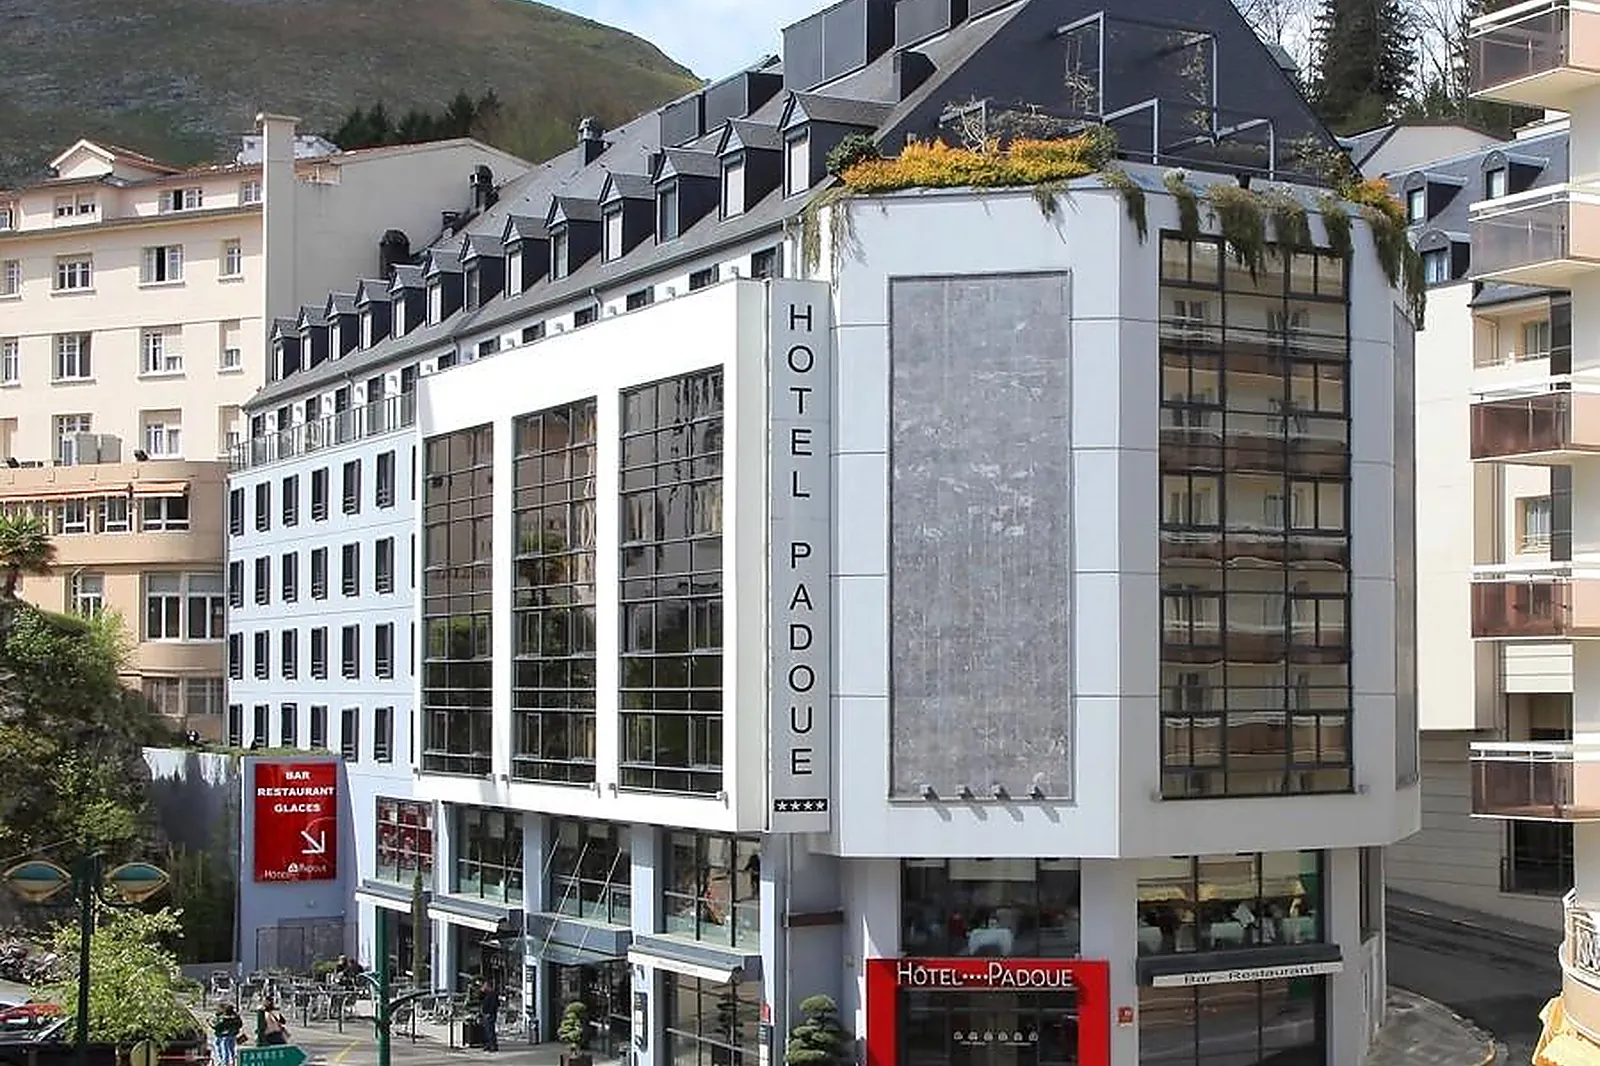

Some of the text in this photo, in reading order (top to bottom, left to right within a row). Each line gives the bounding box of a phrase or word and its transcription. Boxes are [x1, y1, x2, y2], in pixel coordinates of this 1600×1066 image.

[787, 304, 815, 775] HOTEL PADOUE
[285, 771, 311, 780] BAR
[257, 786, 335, 797] RESTAURANT
[273, 803, 321, 813] GLACES
[988, 962, 1073, 986] PADOUE
[1229, 966, 1315, 981] Restaurant
